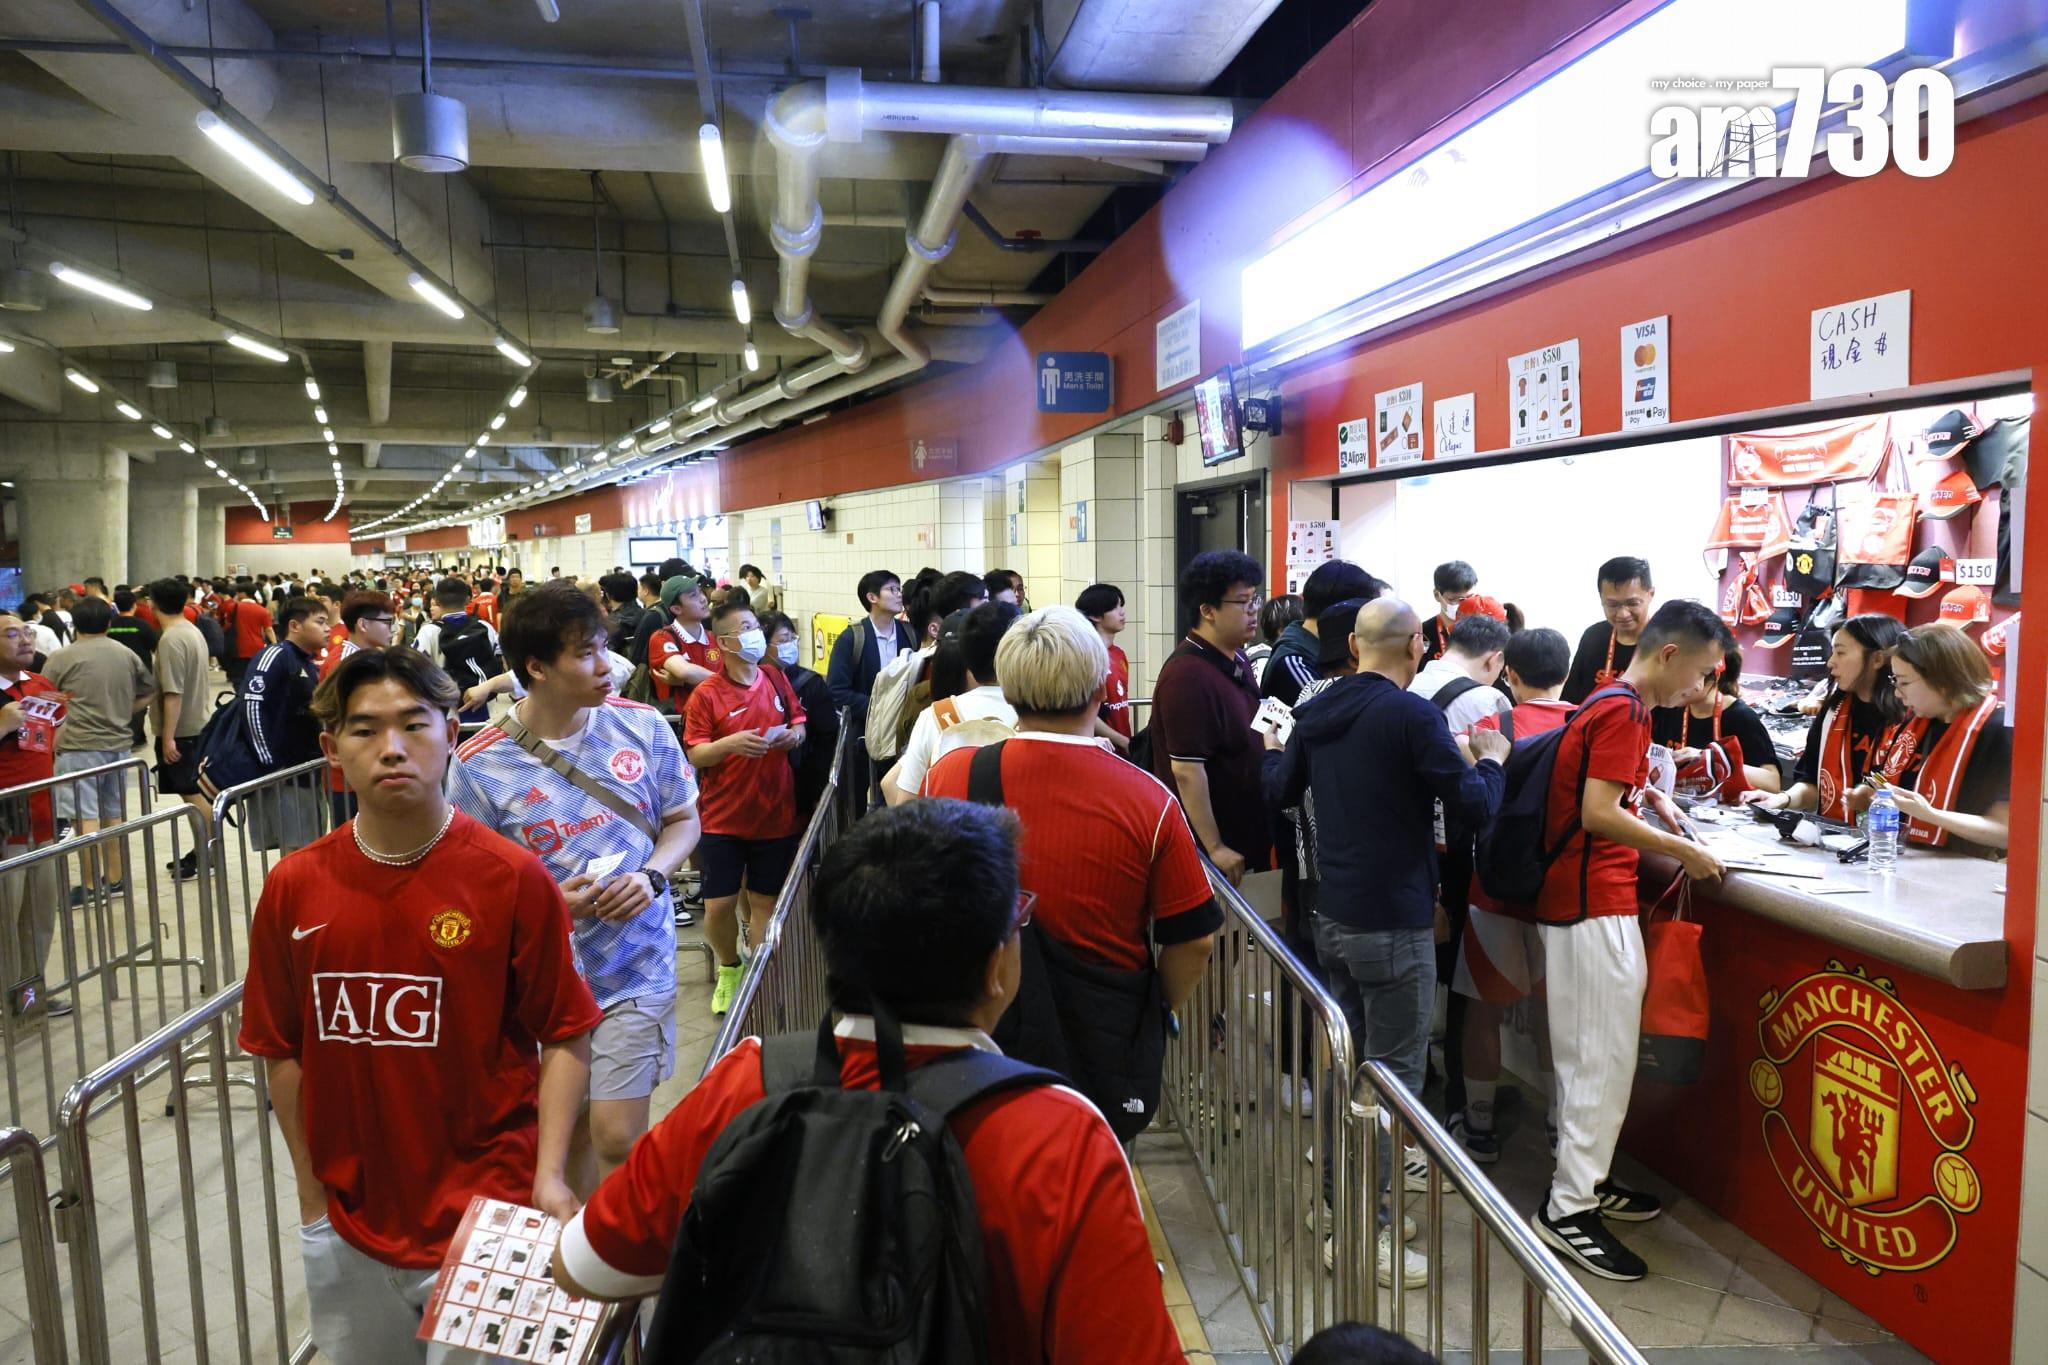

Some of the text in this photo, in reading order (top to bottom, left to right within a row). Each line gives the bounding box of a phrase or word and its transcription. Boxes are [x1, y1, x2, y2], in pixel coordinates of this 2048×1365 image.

[1819, 302, 1877, 341] CASH
[1635, 323, 1656, 339] VISA
[1542, 346, 1562, 365] $580
[1086, 382, 1104, 390] Toilet
[1652, 406, 1667, 418] Pay
[1348, 451, 1366, 466] Alipay
[1960, 564, 1993, 579] $150
[1776, 591, 1800, 602] $150
[328, 980, 431, 1038] AIG
[1772, 984, 1954, 1124] MANCHESTER
[1792, 1165, 1917, 1258] UNITED
